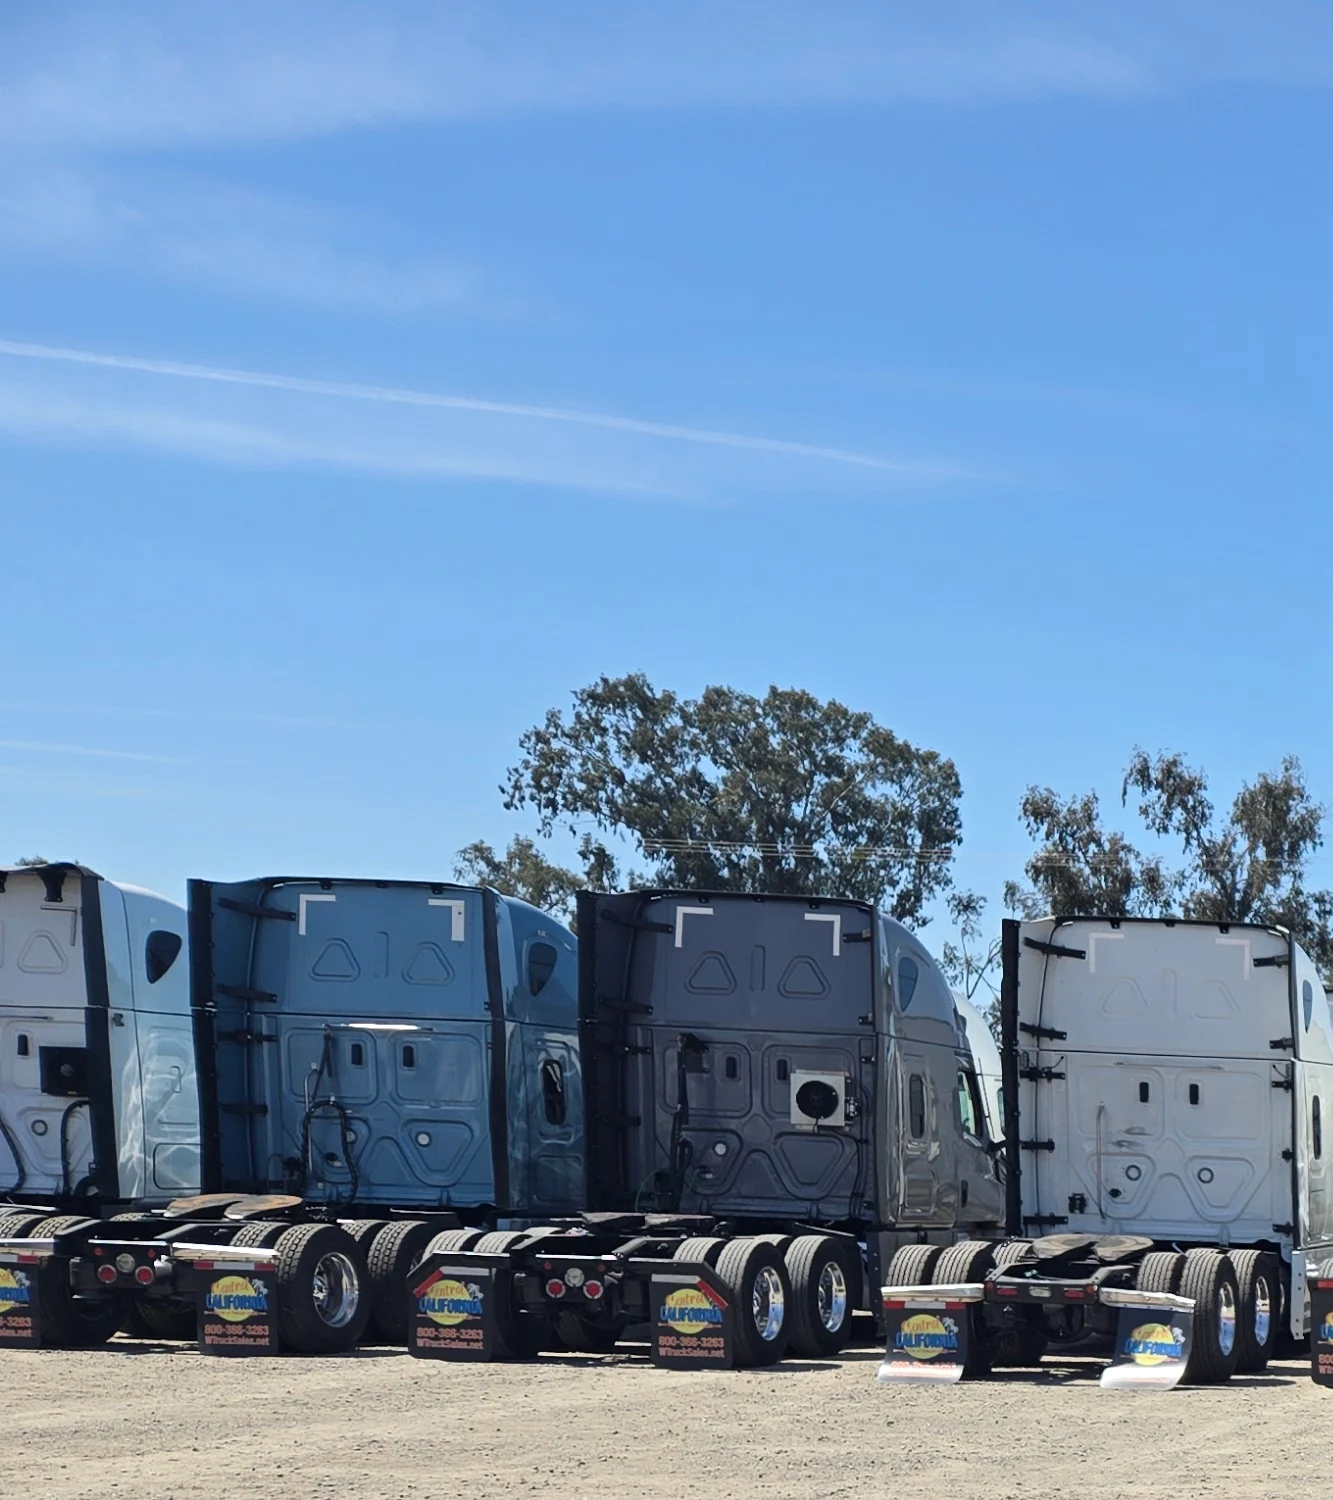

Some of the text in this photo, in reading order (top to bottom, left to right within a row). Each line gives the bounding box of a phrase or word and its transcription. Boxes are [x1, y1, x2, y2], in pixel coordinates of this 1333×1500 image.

[206, 1294, 267, 1309] CALIFORNIA
[419, 1298, 482, 1314] CALIFORNIA
[660, 1306, 723, 1322] CALIFORNIA
